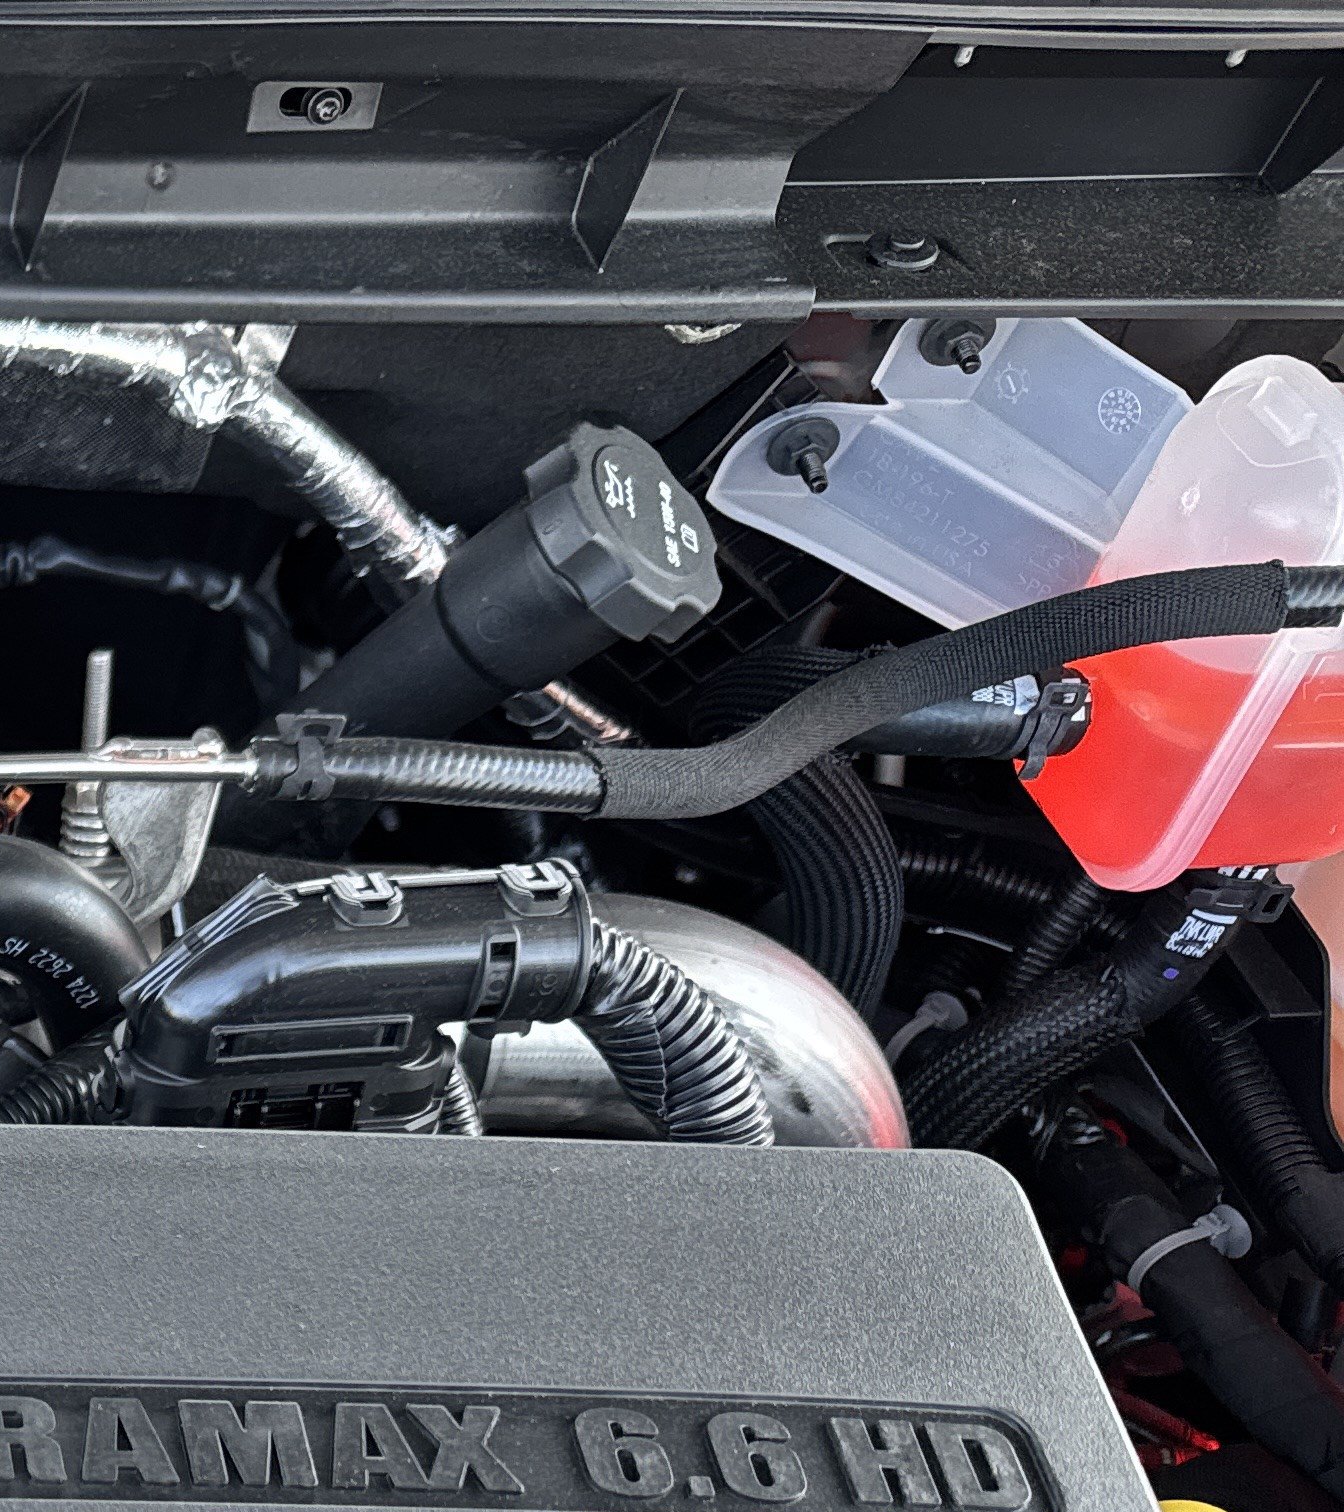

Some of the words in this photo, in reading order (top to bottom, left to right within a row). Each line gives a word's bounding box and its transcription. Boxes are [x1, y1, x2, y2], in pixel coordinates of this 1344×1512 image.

[665, 535, 681, 568] SAE
[28, 947, 75, 979] 2622
[573, 1406, 807, 1503] 6.6
[826, 1414, 1033, 1511] HD
